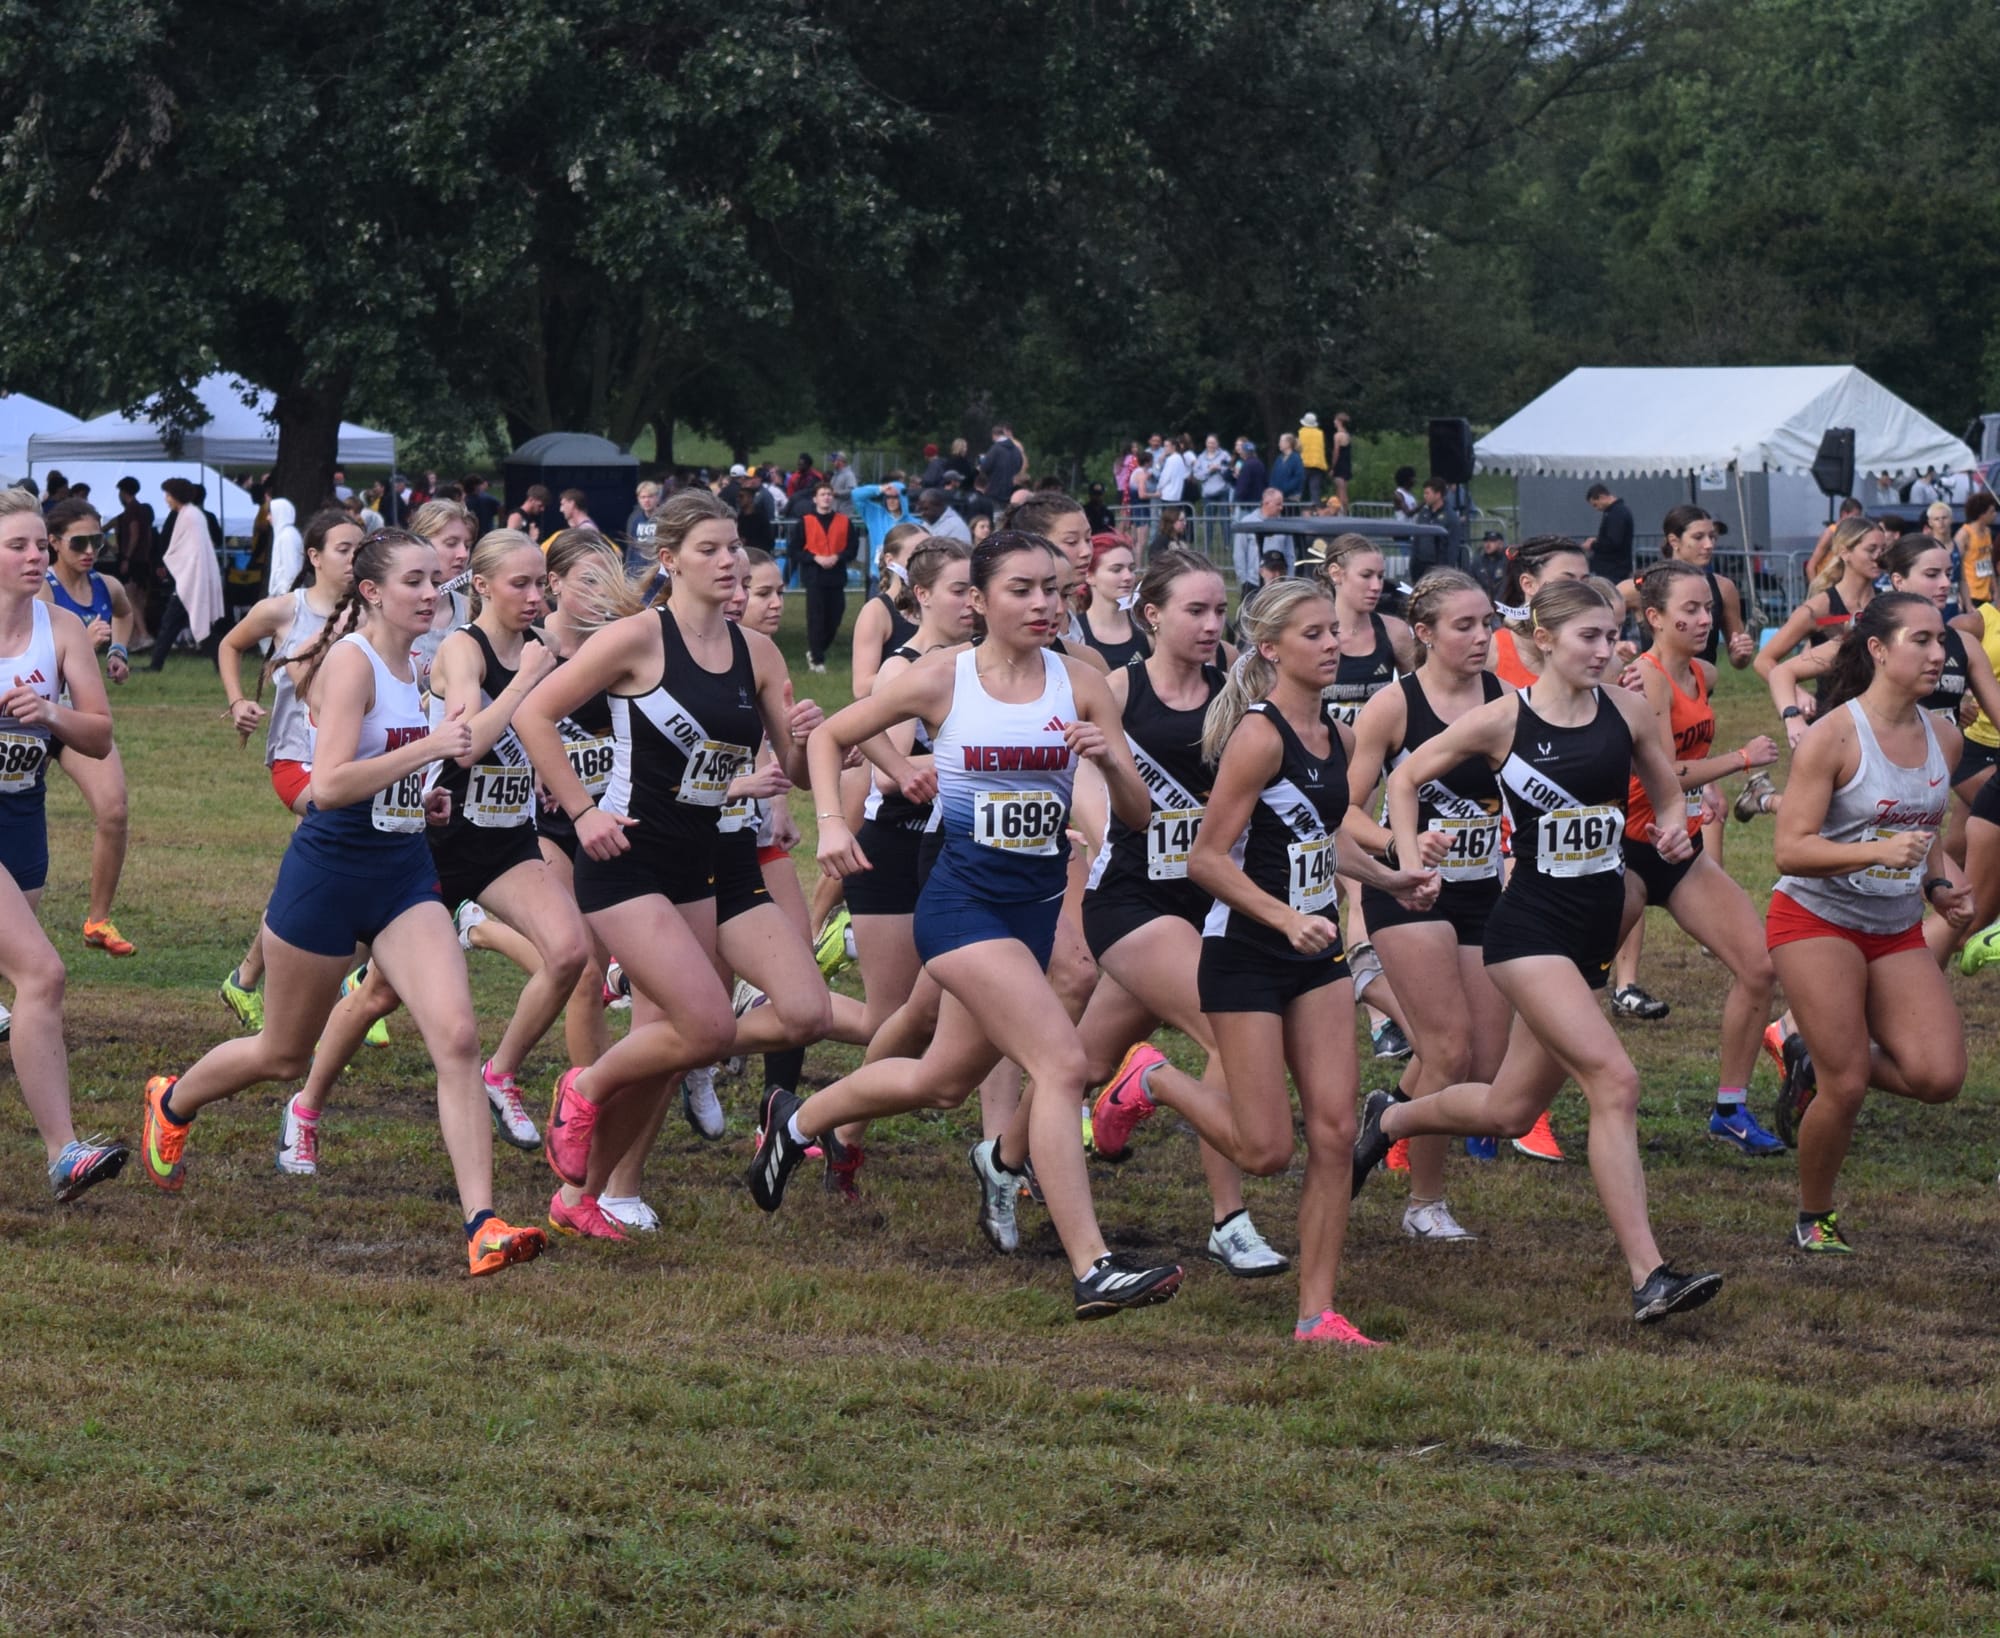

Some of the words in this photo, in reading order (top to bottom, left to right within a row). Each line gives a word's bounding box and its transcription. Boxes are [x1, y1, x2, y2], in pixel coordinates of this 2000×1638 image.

[1332, 707, 1356, 727] 14
[961, 745, 1070, 771] NEWMAN
[384, 774, 422, 808] 168
[473, 775, 530, 805] 1459
[980, 801, 1061, 838] 1693
[1544, 816, 1617, 852] 1461
[1440, 825, 1497, 859] 467
